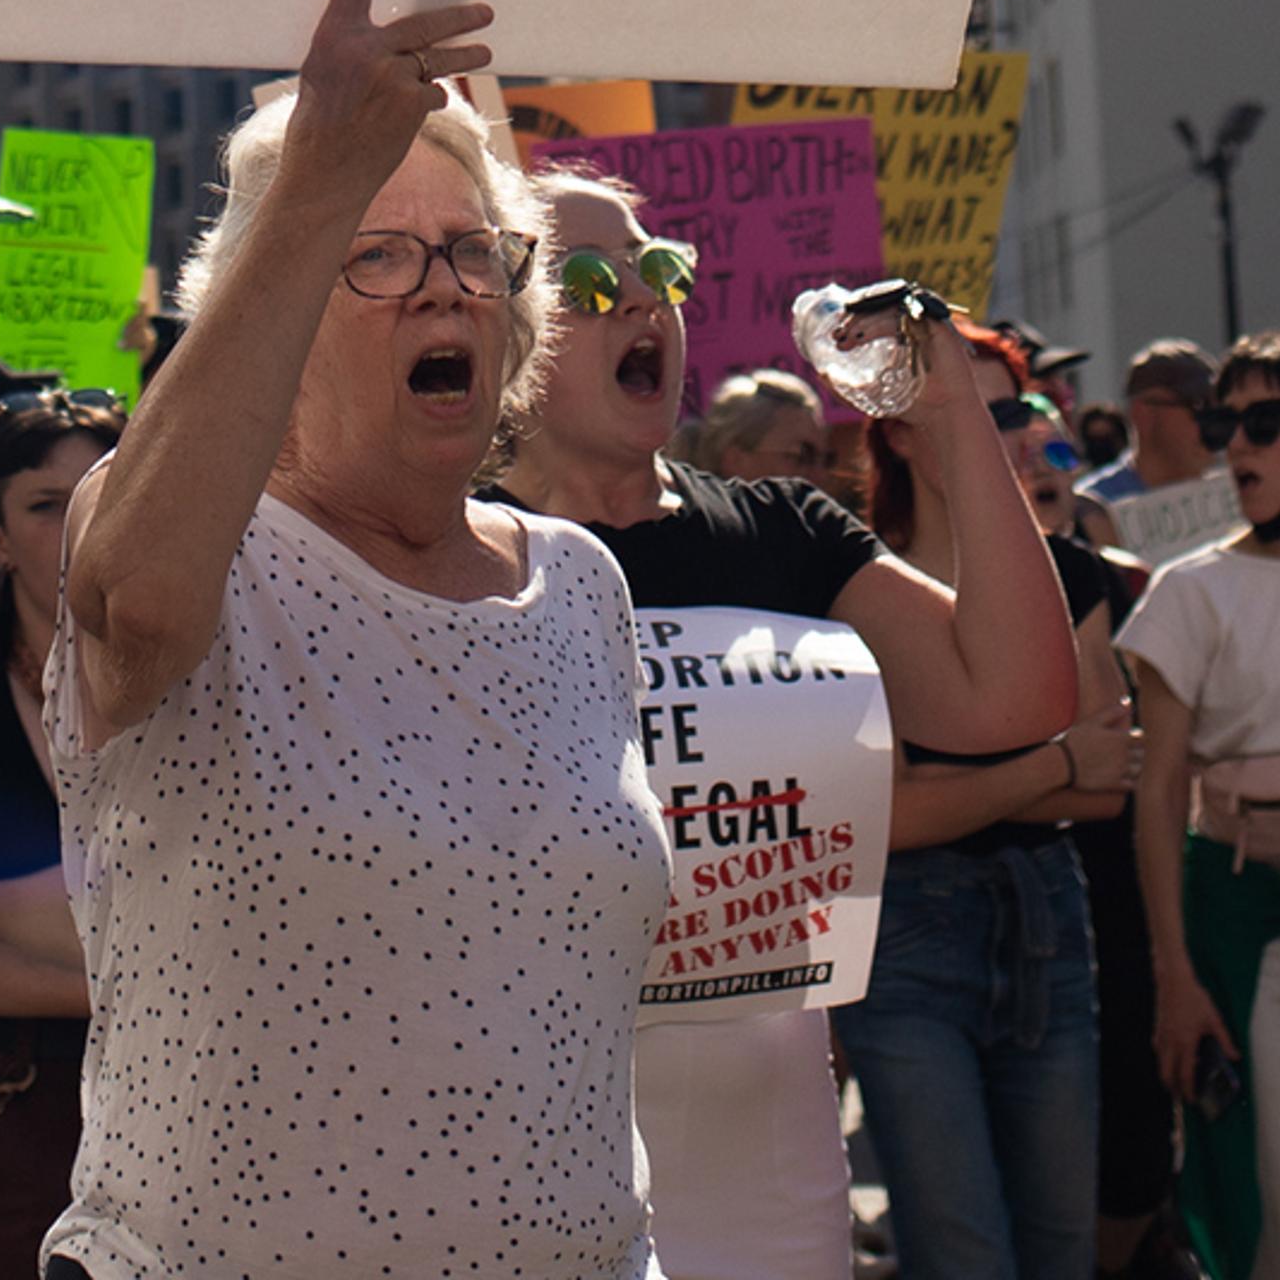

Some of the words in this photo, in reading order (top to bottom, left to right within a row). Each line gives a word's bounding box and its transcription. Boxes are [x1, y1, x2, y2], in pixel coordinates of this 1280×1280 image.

[725, 134, 844, 203] BIRTH
[641, 650, 847, 691] ORTION
[640, 702, 705, 767] FE
[671, 776, 812, 850] EGAL
[691, 823, 855, 900] SCOTUS
[723, 862, 853, 929] DOING
[660, 906, 834, 978] ANYWAY
[641, 963, 831, 1004] BORTIONPILL.INFO
